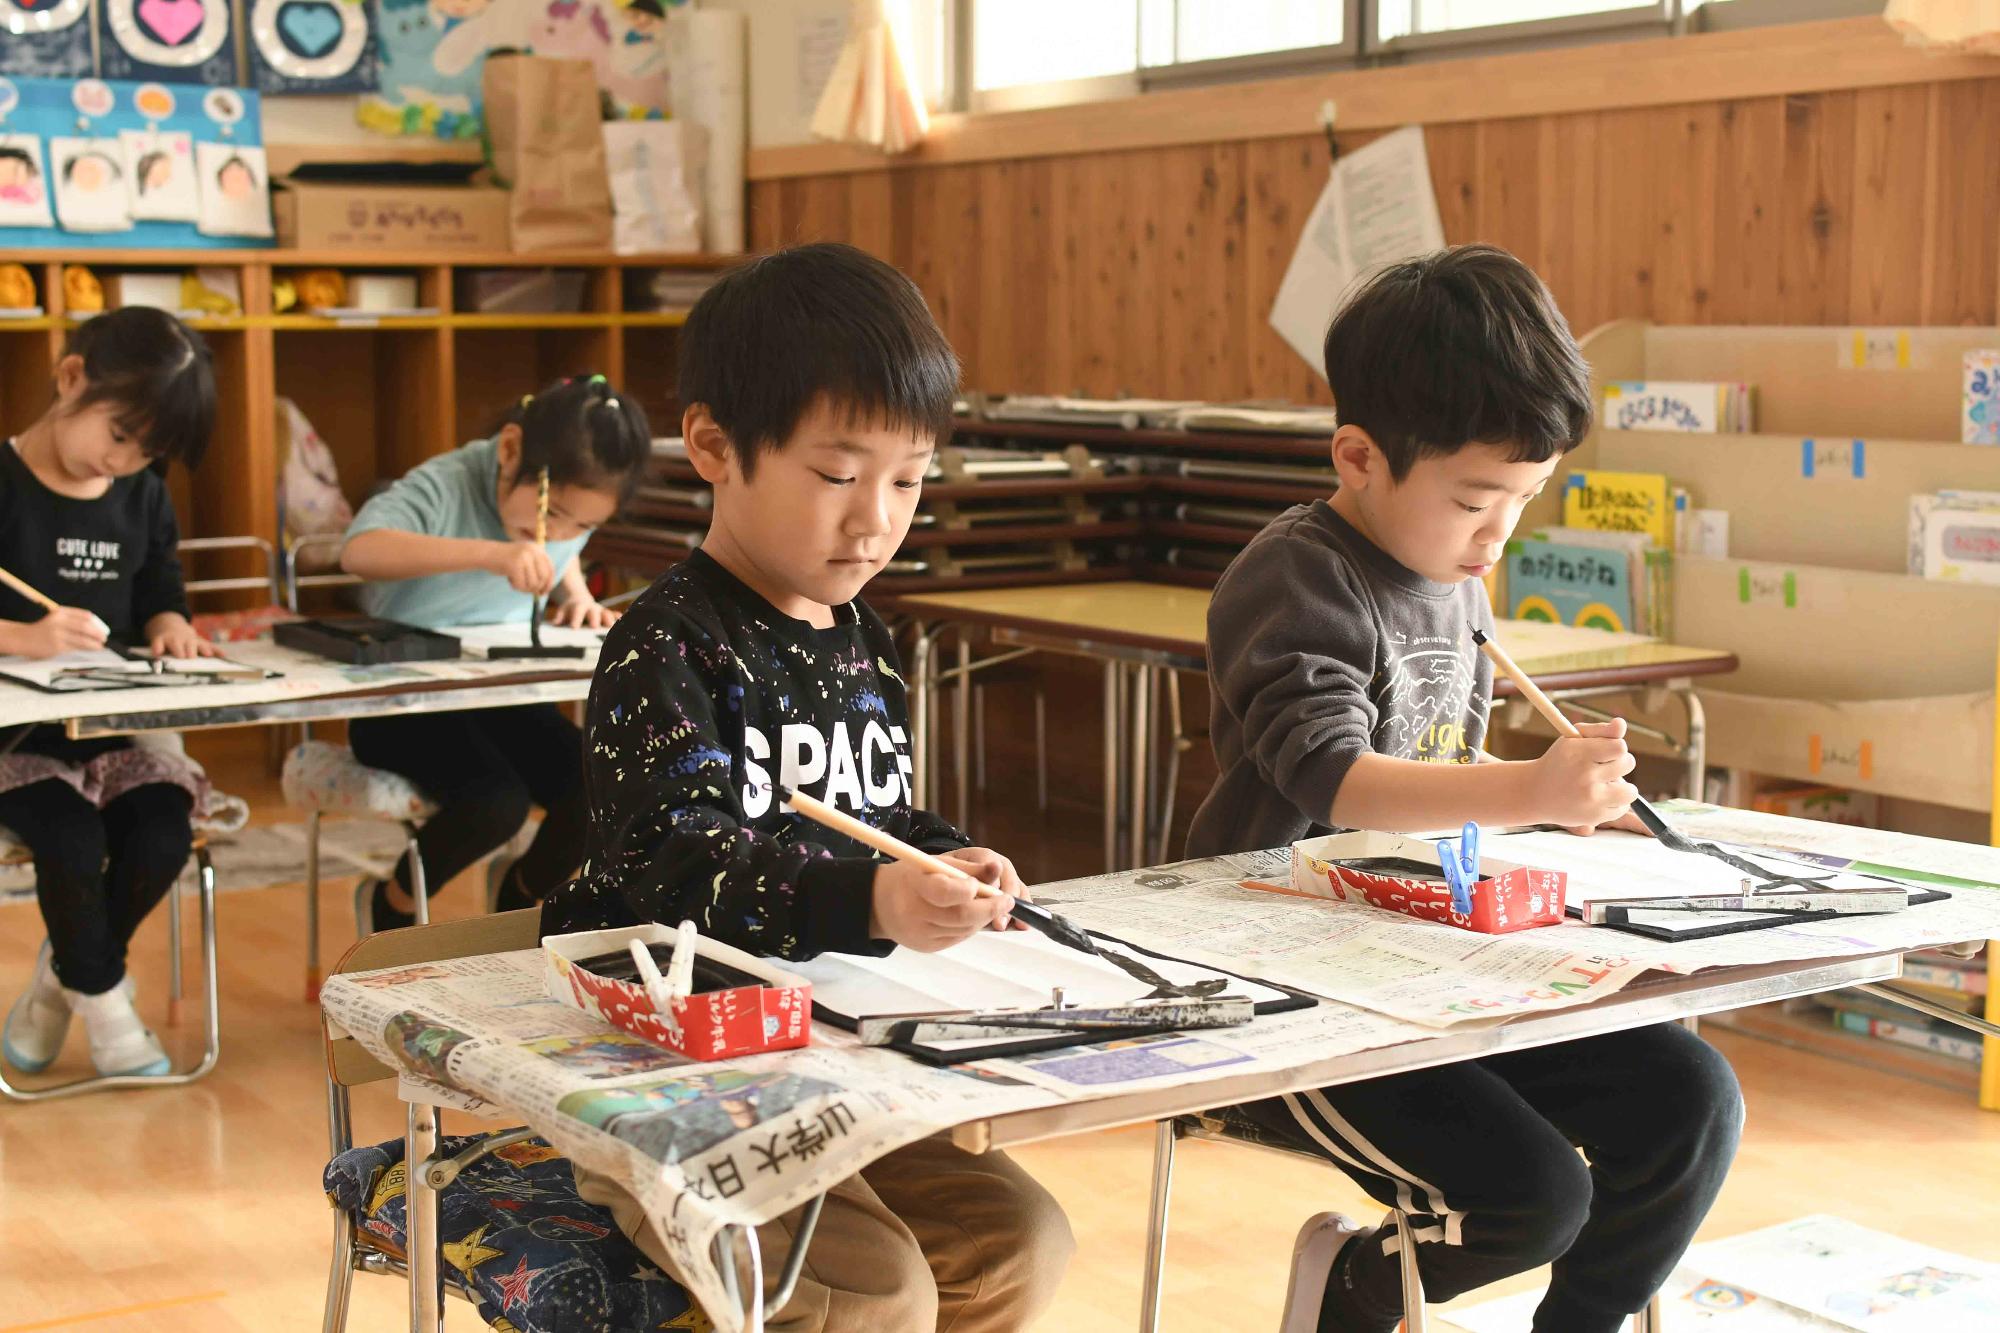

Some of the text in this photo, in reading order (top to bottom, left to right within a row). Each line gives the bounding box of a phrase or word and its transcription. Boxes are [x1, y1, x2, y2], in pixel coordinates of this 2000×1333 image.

[56, 538, 120, 560] CUTE LOVE
[743, 720, 912, 818] SPACE
